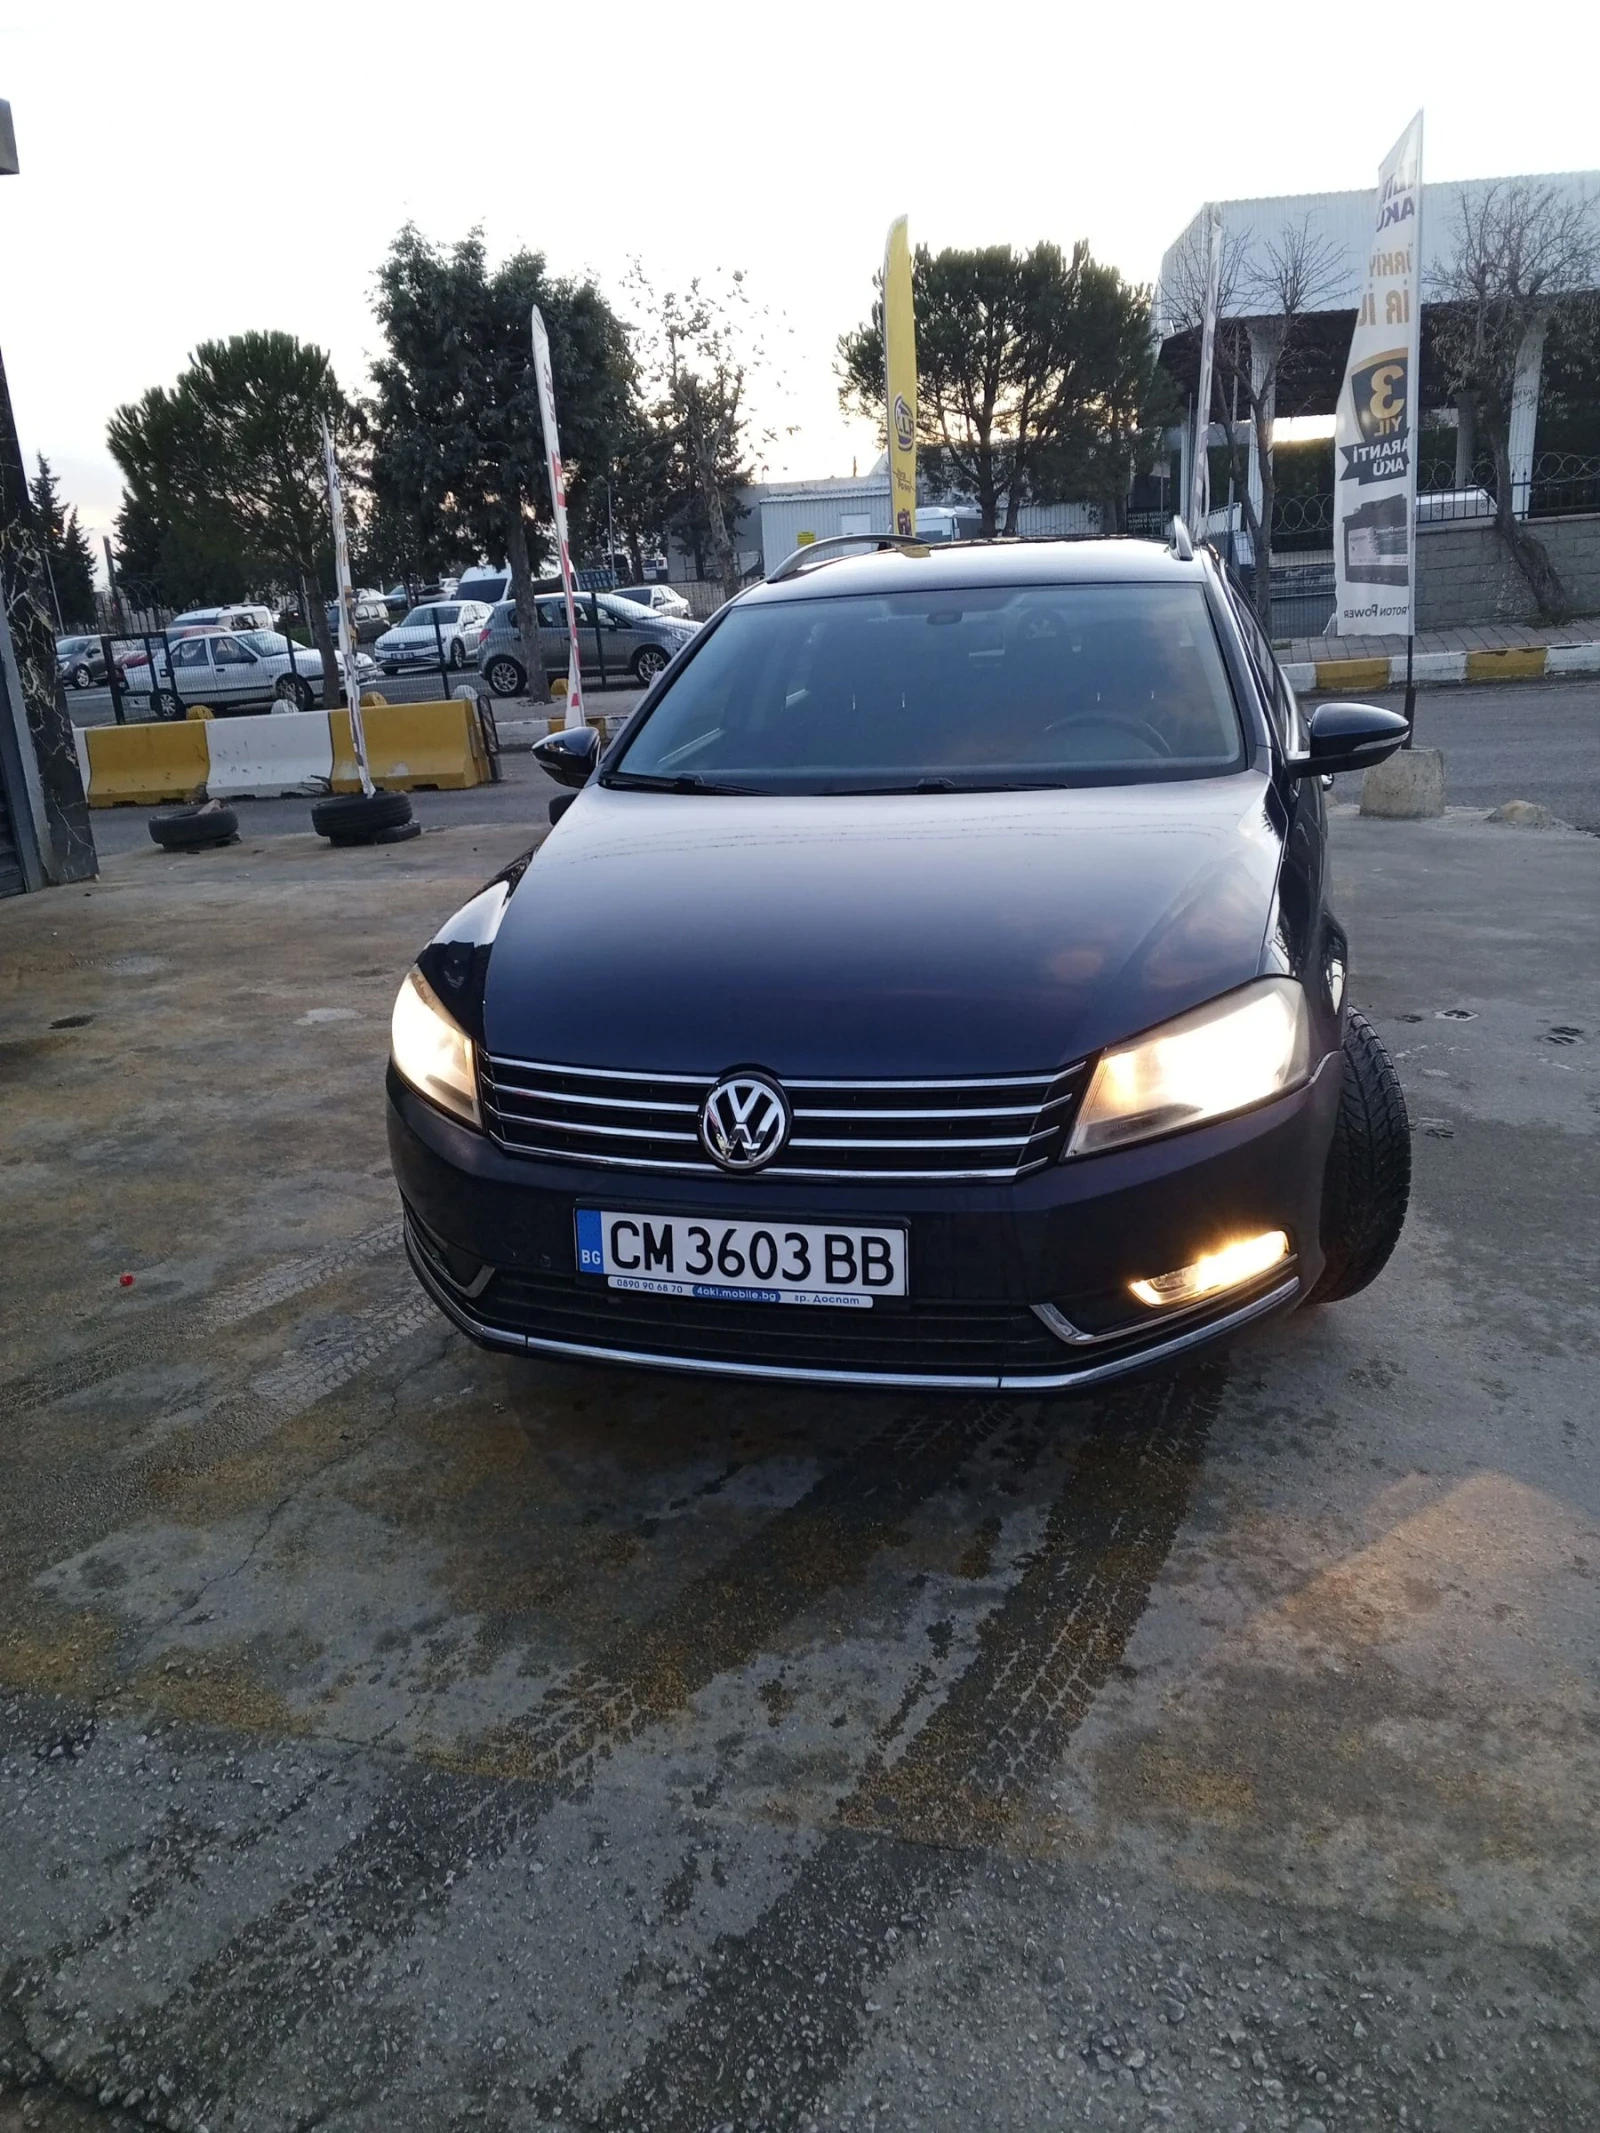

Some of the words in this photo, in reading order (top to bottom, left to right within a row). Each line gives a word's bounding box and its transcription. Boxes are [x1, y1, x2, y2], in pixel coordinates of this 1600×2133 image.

[581, 1249, 601, 1265] BG
[610, 1220, 675, 1274] CM
[685, 1226, 812, 1282] 3603
[824, 1233, 895, 1287] BB
[616, 1278, 640, 1289] 0890
[642, 1281, 654, 1291] 90
[656, 1283, 669, 1292] 68
[671, 1284, 683, 1294] 70
